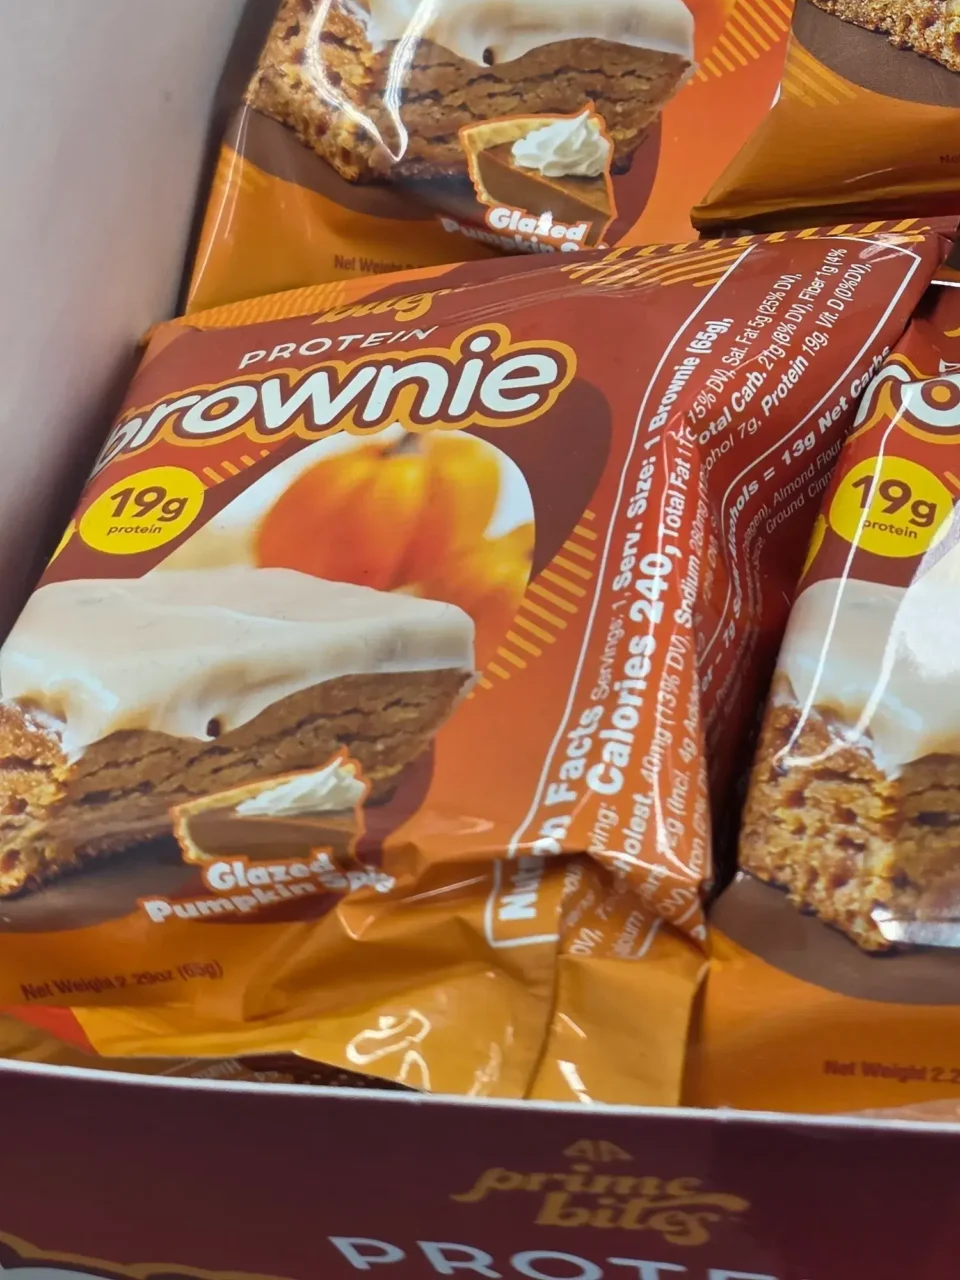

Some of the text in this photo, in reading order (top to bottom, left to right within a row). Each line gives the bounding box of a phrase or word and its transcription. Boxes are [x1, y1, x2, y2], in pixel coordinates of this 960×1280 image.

[488, 207, 588, 240] Glazed
[334, 255, 356, 269] Net
[815, 262, 839, 277] 1g
[822, 245, 847, 266] (4%
[775, 269, 802, 292] DV),
[798, 276, 827, 302] Fiber
[749, 313, 772, 329] 5g
[757, 288, 787, 317] (25%
[785, 300, 813, 322] DV),
[239, 326, 438, 369] PROTEIN
[686, 314, 734, 356] (65g),
[737, 326, 759, 344] Fat
[769, 319, 797, 345] (8%
[722, 344, 749, 366] Sat.
[736, 417, 763, 437] 7g,
[759, 346, 814, 415] Protein
[798, 328, 830, 355] 19g,
[816, 310, 839, 328] Vit.
[828, 298, 845, 310] D
[757, 342, 784, 368] 21g
[648, 353, 701, 429] Brownie
[704, 365, 737, 391] DV),
[727, 367, 767, 412] Carb.
[685, 390, 718, 419] 15%
[646, 434, 660, 444] 1
[696, 413, 731, 443] otal
[779, 432, 818, 463] 13g
[815, 395, 850, 433] Net
[627, 455, 657, 518] Size:
[667, 457, 690, 487] Fat
[772, 463, 816, 504] Almond
[109, 485, 189, 522] 19g
[657, 489, 685, 537] Total
[764, 493, 806, 532] Ground
[852, 472, 938, 528] 19g
[107, 523, 162, 536] protein
[612, 523, 642, 592] Serv.
[627, 543, 683, 626] 240,
[666, 634, 690, 670] DV),
[584, 631, 658, 795] Calories
[652, 671, 682, 725] (13%
[545, 702, 604, 805] Facts
[614, 790, 656, 873] holest.
[206, 851, 336, 891] Glazed
[144, 881, 317, 923] Pumpkin
[20, 979, 53, 1002] Net
[57, 974, 115, 996] Weight
[177, 960, 224, 981] (65g)
[824, 1060, 856, 1077] Net
[861, 1062, 927, 1084] Weight
[450, 1163, 704, 1203] prime
[534, 1192, 750, 1247] bites
